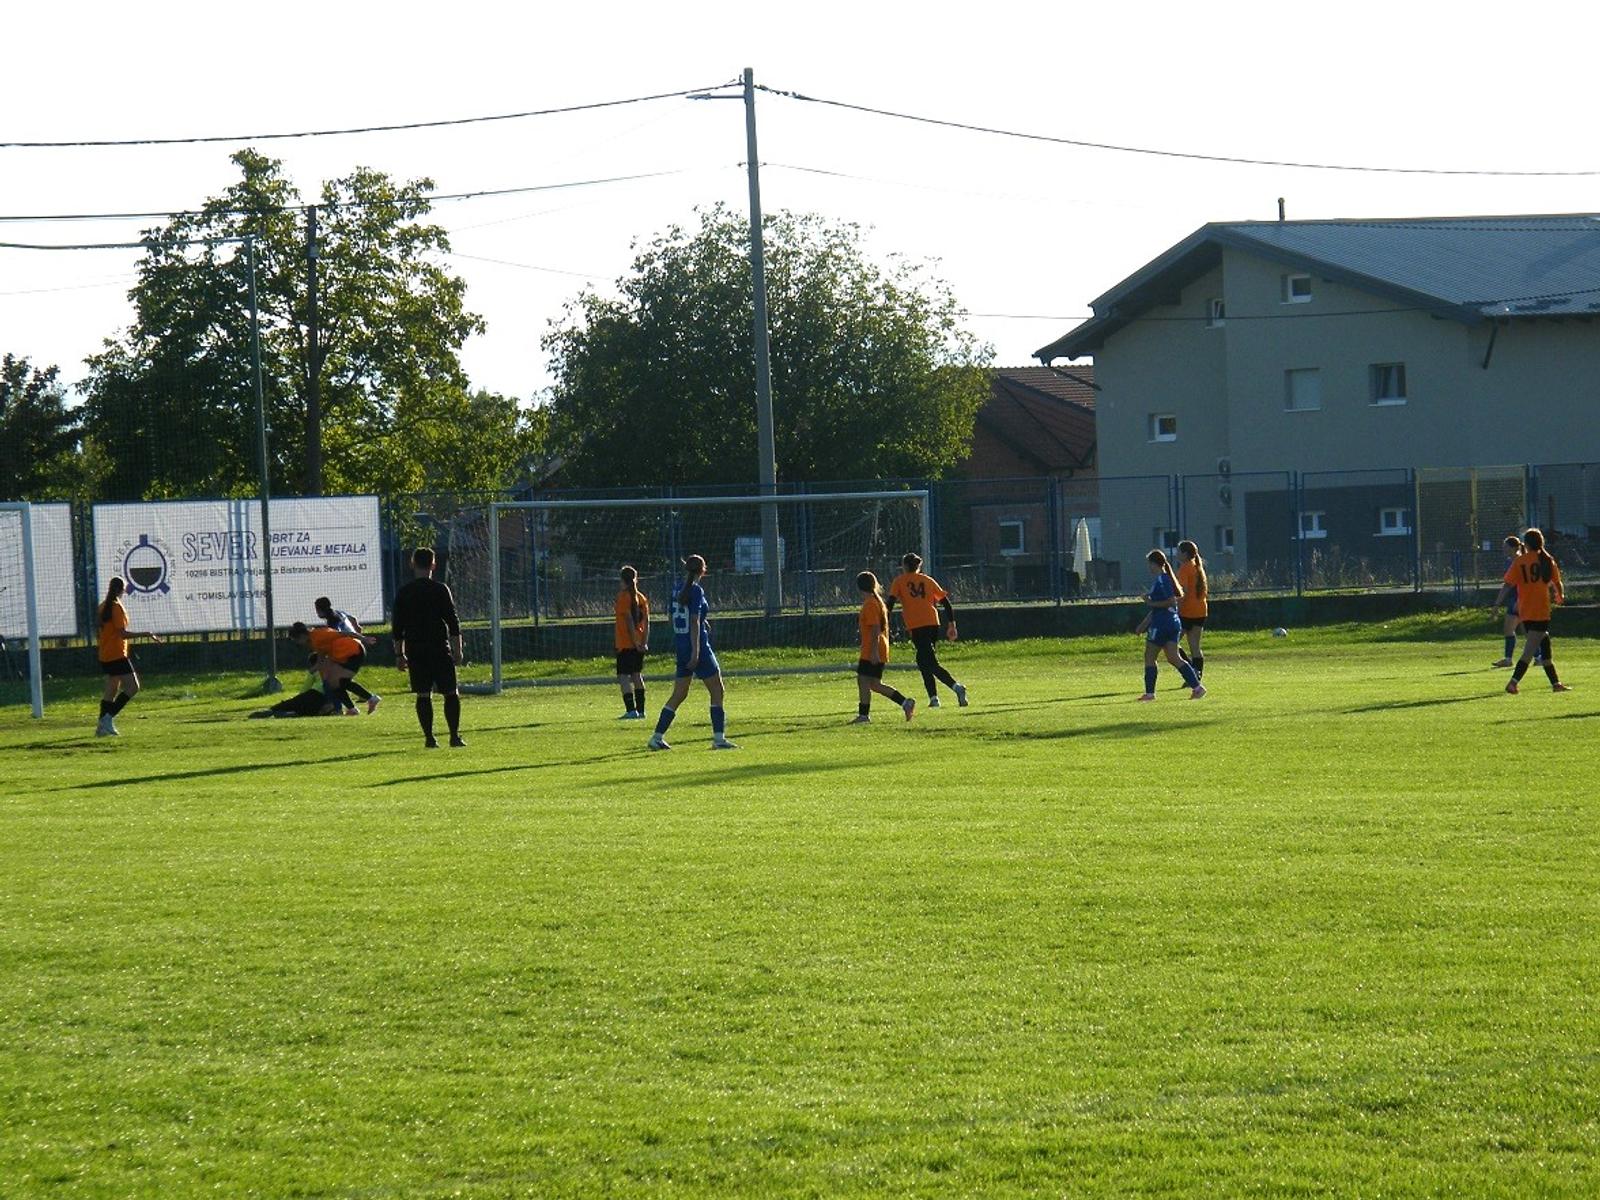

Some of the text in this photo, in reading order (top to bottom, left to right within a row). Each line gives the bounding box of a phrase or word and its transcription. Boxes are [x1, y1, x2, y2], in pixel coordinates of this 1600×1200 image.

[268, 532, 310, 543] BRT ZA
[182, 530, 258, 563] SEVER
[324, 543, 367, 554] METALA
[1520, 562, 1540, 583] 19
[197, 591, 236, 600] TOMISLAV
[907, 581, 926, 599] 34
